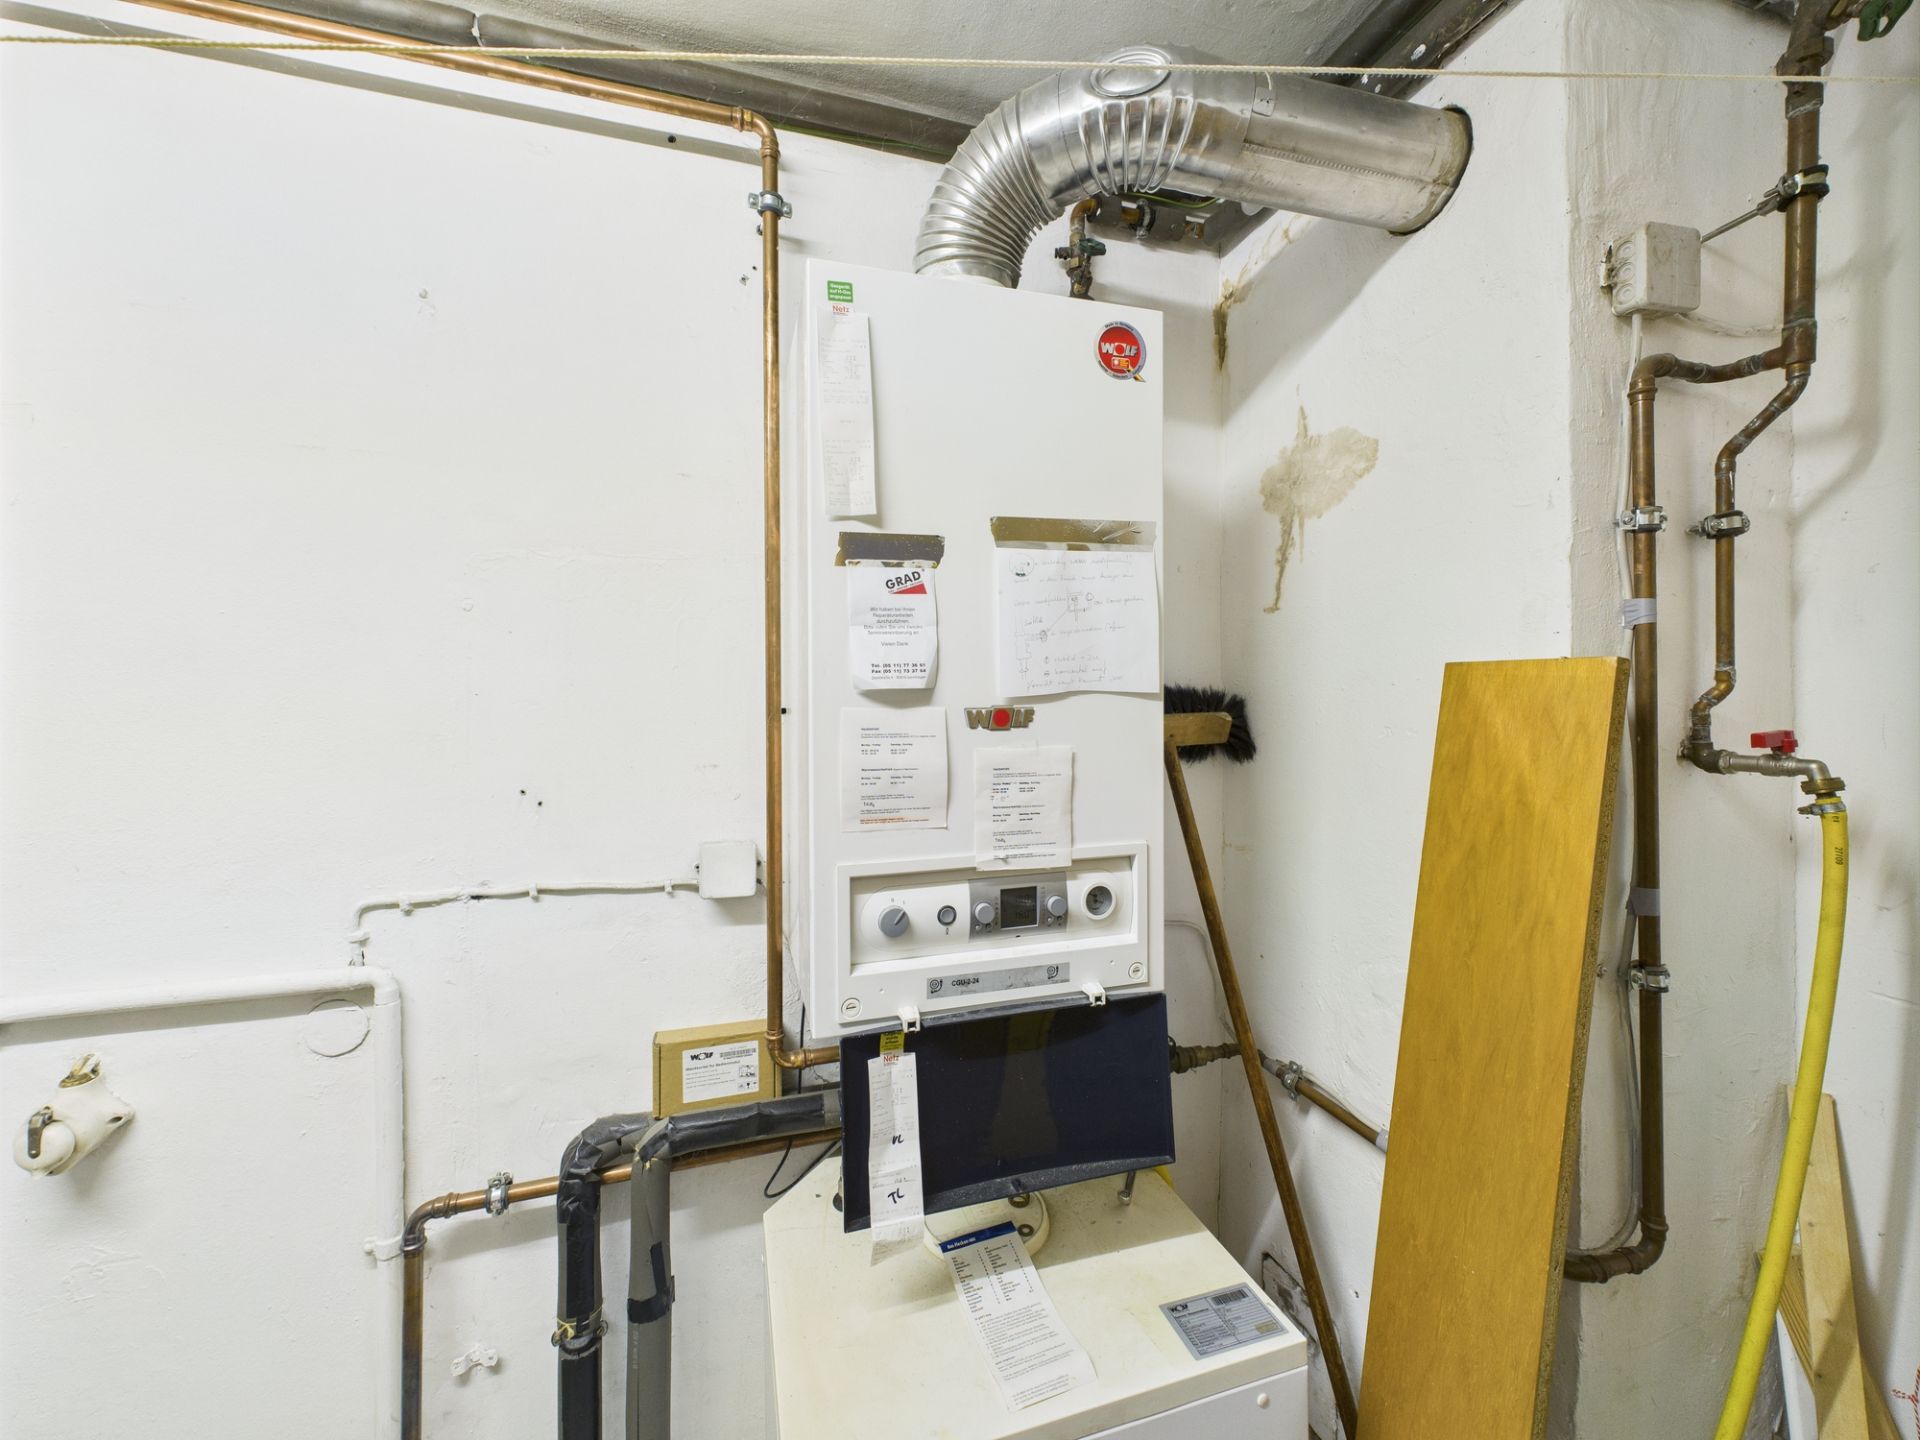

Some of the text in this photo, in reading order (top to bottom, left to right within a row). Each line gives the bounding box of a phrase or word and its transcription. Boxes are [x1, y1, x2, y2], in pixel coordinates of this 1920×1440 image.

[1101, 342, 1138, 357] WOLF
[885, 571, 921, 590] GRAD
[964, 705, 1035, 731] WOLF
[951, 977, 980, 987] CGU-2-24
[690, 1052, 713, 1061] WOLF
[883, 1054, 900, 1063] Netz
